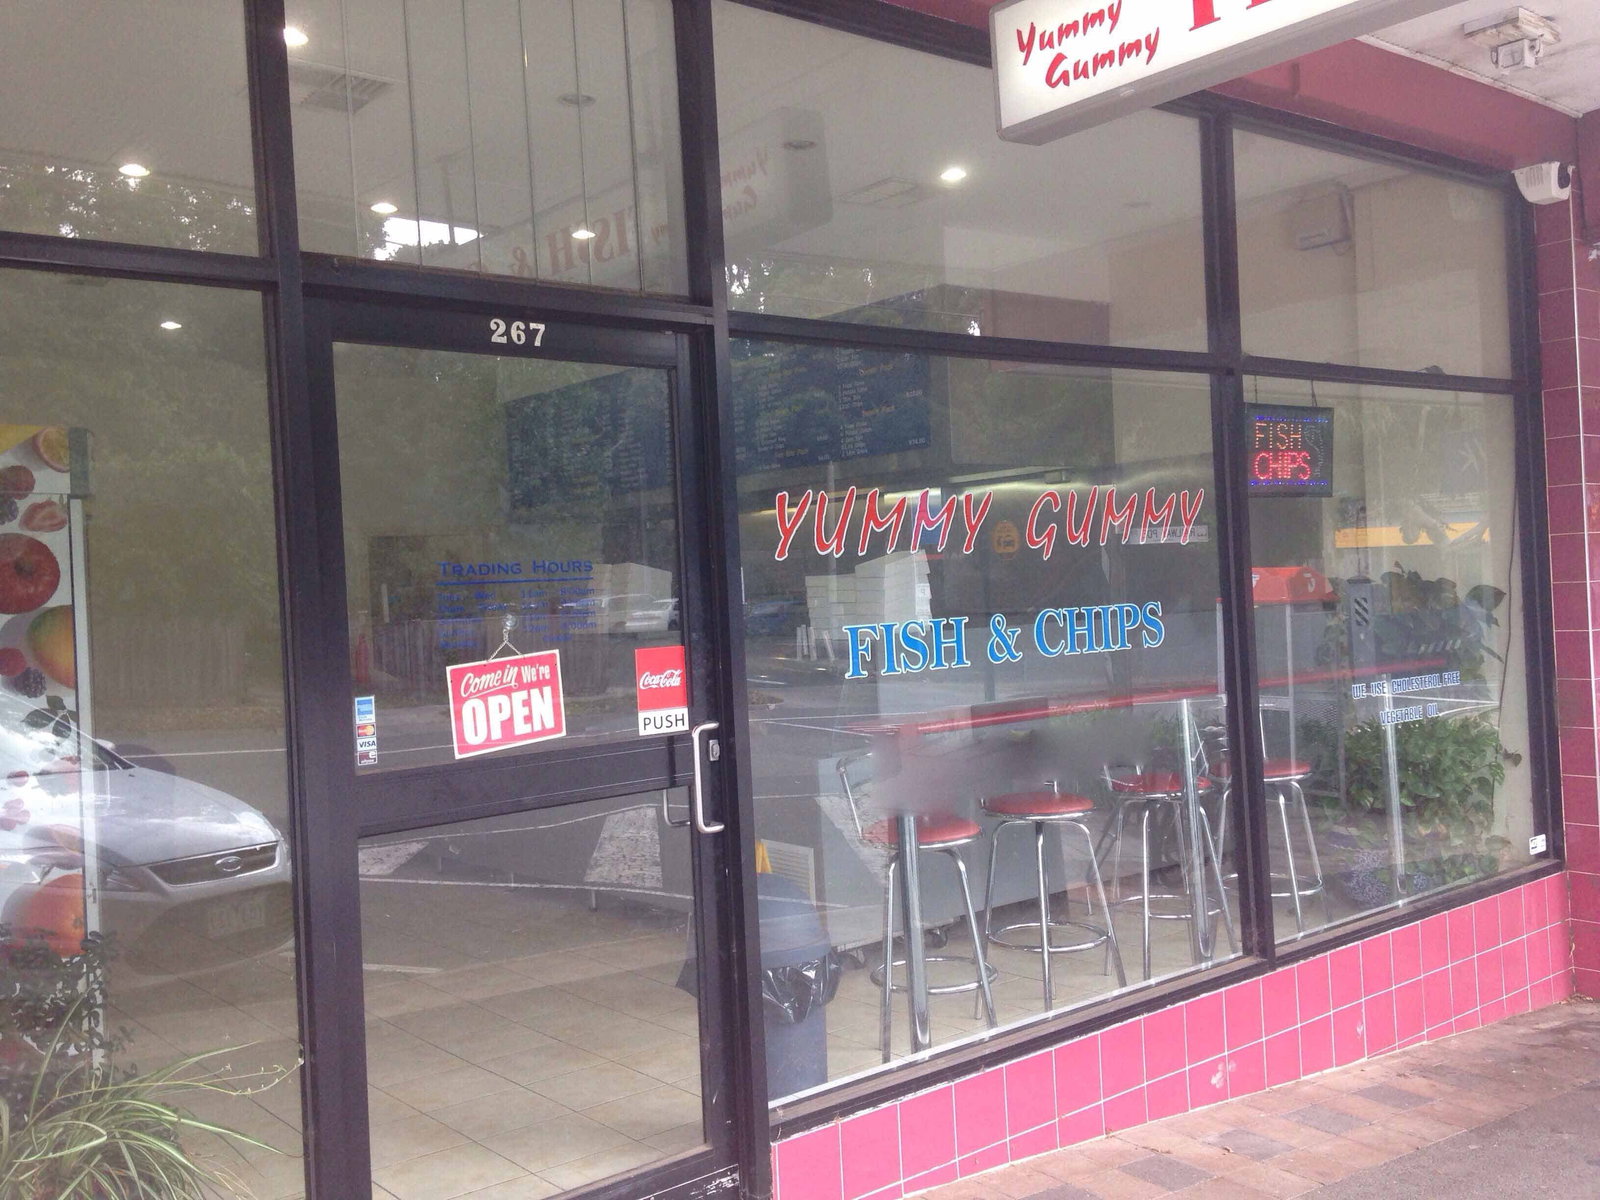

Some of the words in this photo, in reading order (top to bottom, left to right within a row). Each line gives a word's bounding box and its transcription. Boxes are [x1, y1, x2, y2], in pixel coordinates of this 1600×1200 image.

[1016, 0, 1122, 66] Yummy
[1045, 26, 1160, 89] Gummy
[489, 318, 546, 347] 267
[1255, 422, 1302, 450] FISH
[1253, 450, 1311, 480] CHIPS
[774, 486, 994, 561] YUMMY
[1025, 486, 1205, 561] GUMMY
[438, 560, 522, 577] TRADING
[532, 559, 594, 574] HOURS
[841, 615, 970, 680] FISH
[986, 613, 1023, 664] &
[1033, 600, 1166, 658] CHIPS
[460, 670, 502, 698] Come
[503, 664, 519, 689] in
[521, 664, 551, 684] We're
[1352, 684, 1367, 700] WE
[1370, 680, 1387, 697] USE
[1391, 673, 1441, 694] CHOLESTEROL
[1442, 671, 1460, 686] FREE
[461, 685, 555, 746] OPEN
[643, 713, 685, 731] PUSH
[1380, 705, 1423, 725] VEGETABLE
[359, 740, 376, 748] VISA
